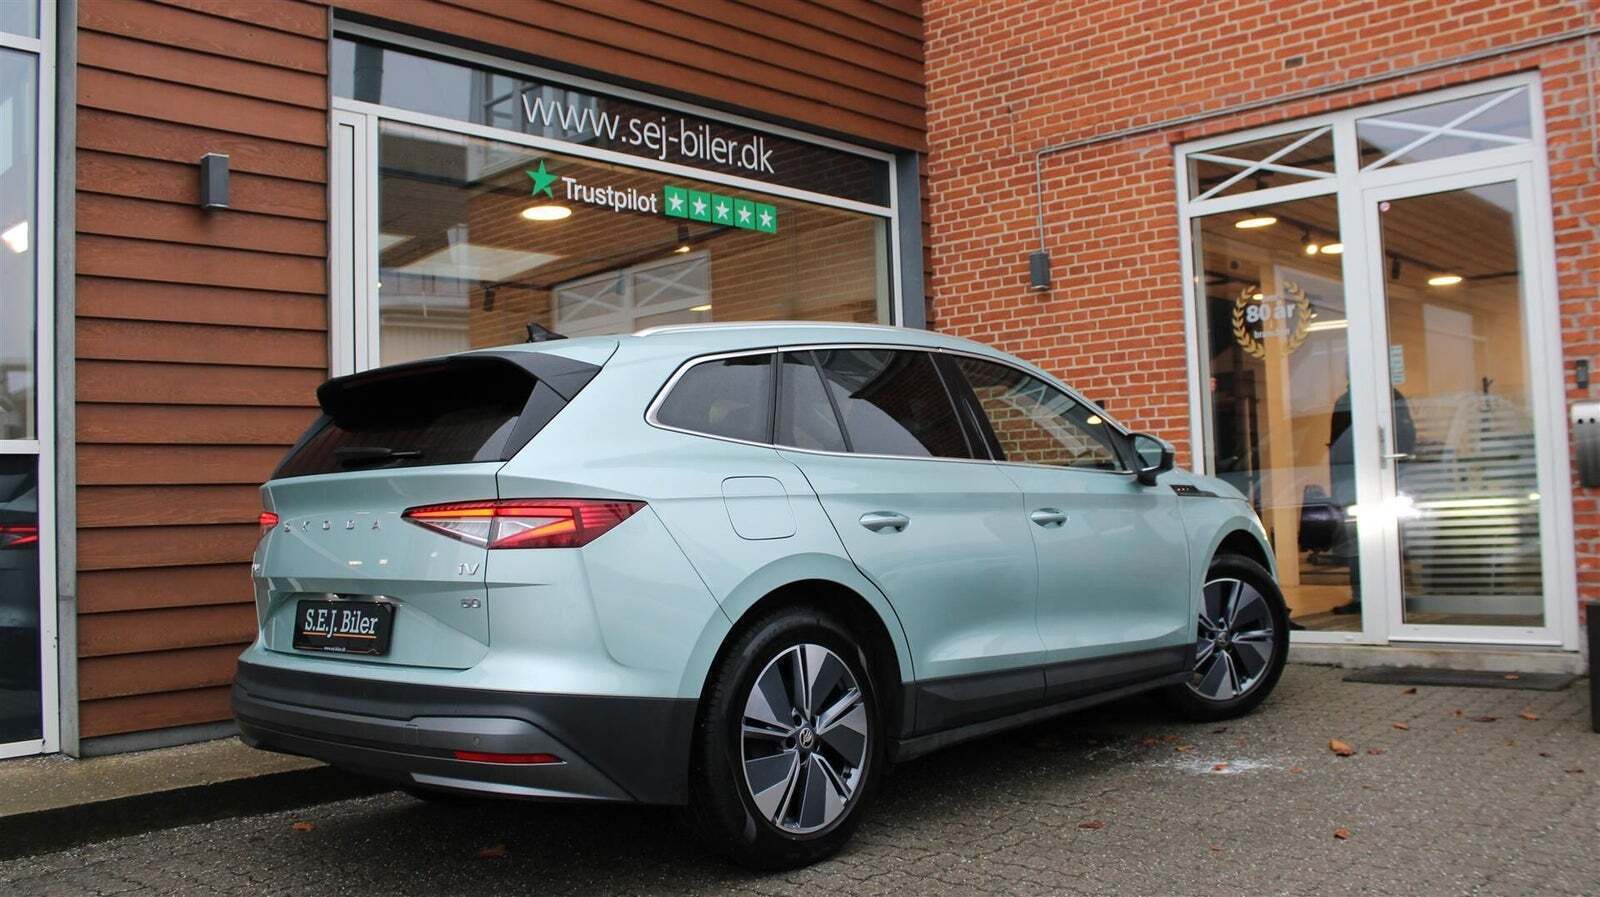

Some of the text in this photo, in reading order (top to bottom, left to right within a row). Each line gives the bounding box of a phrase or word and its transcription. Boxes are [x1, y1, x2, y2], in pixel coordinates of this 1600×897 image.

[522, 93, 775, 174] www.sej-biler.dk
[561, 176, 658, 213] Trustpilot
[1245, 304, 1271, 323] 80
[304, 609, 379, 638] S.E.J. Biler
